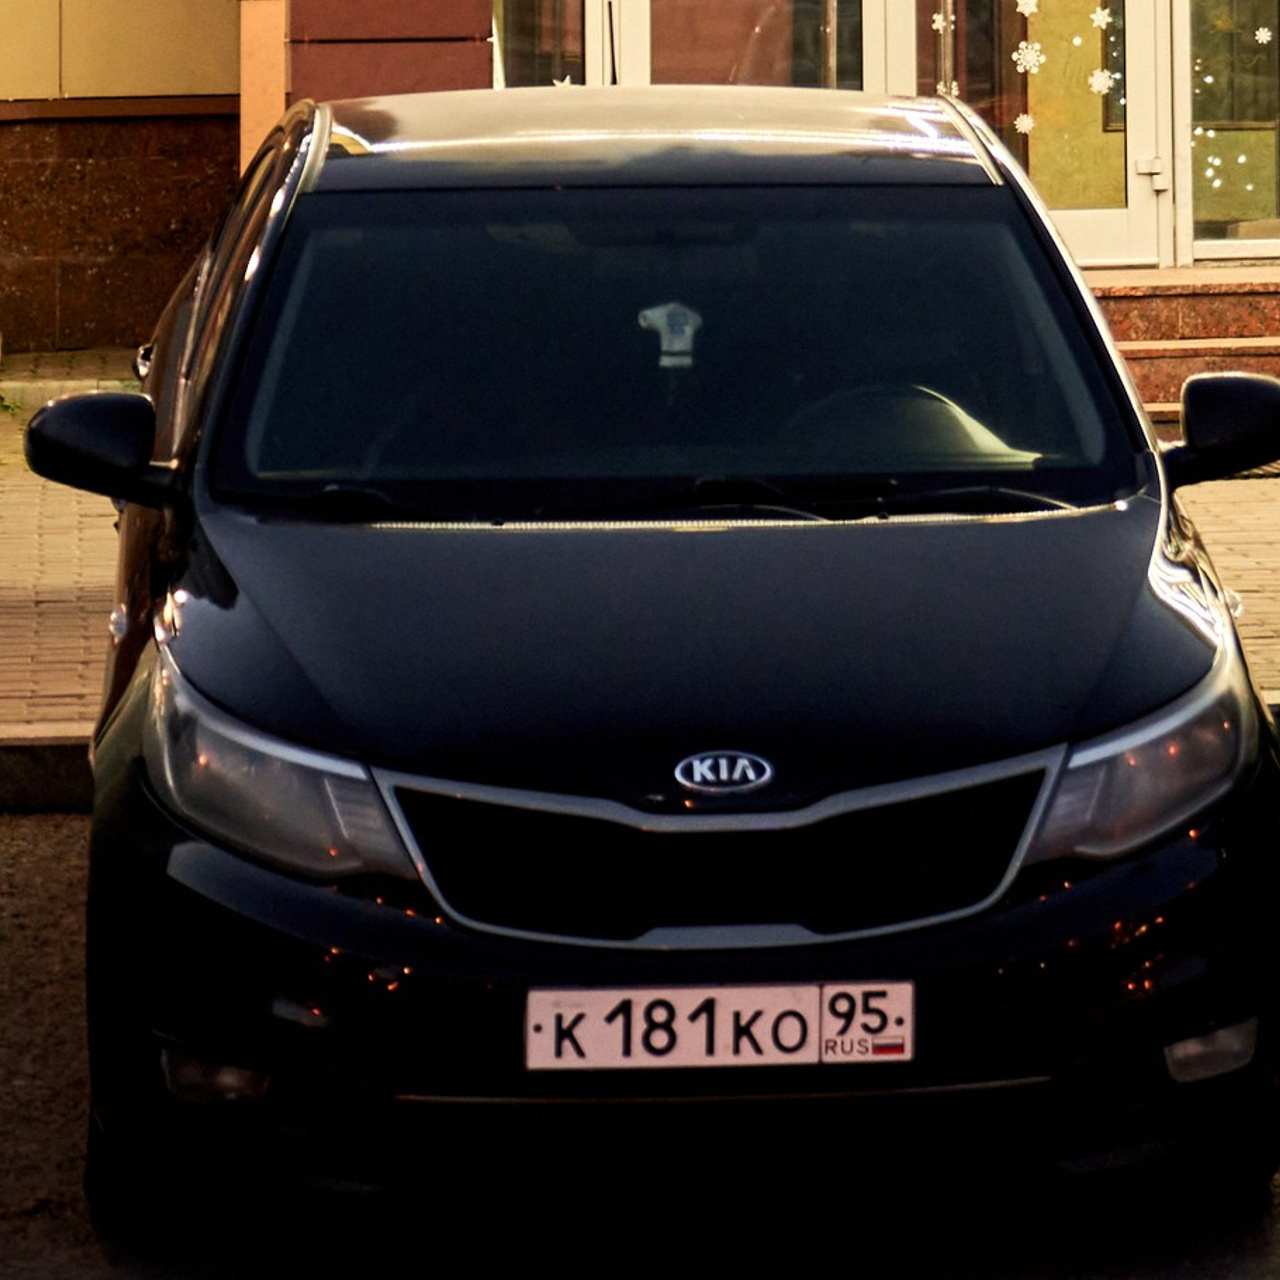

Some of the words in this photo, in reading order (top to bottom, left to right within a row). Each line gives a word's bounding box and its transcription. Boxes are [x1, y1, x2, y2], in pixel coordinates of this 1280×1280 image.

[691, 757, 757, 782] KIA
[827, 990, 888, 1036] 95
[824, 1039, 870, 1055] RUS
